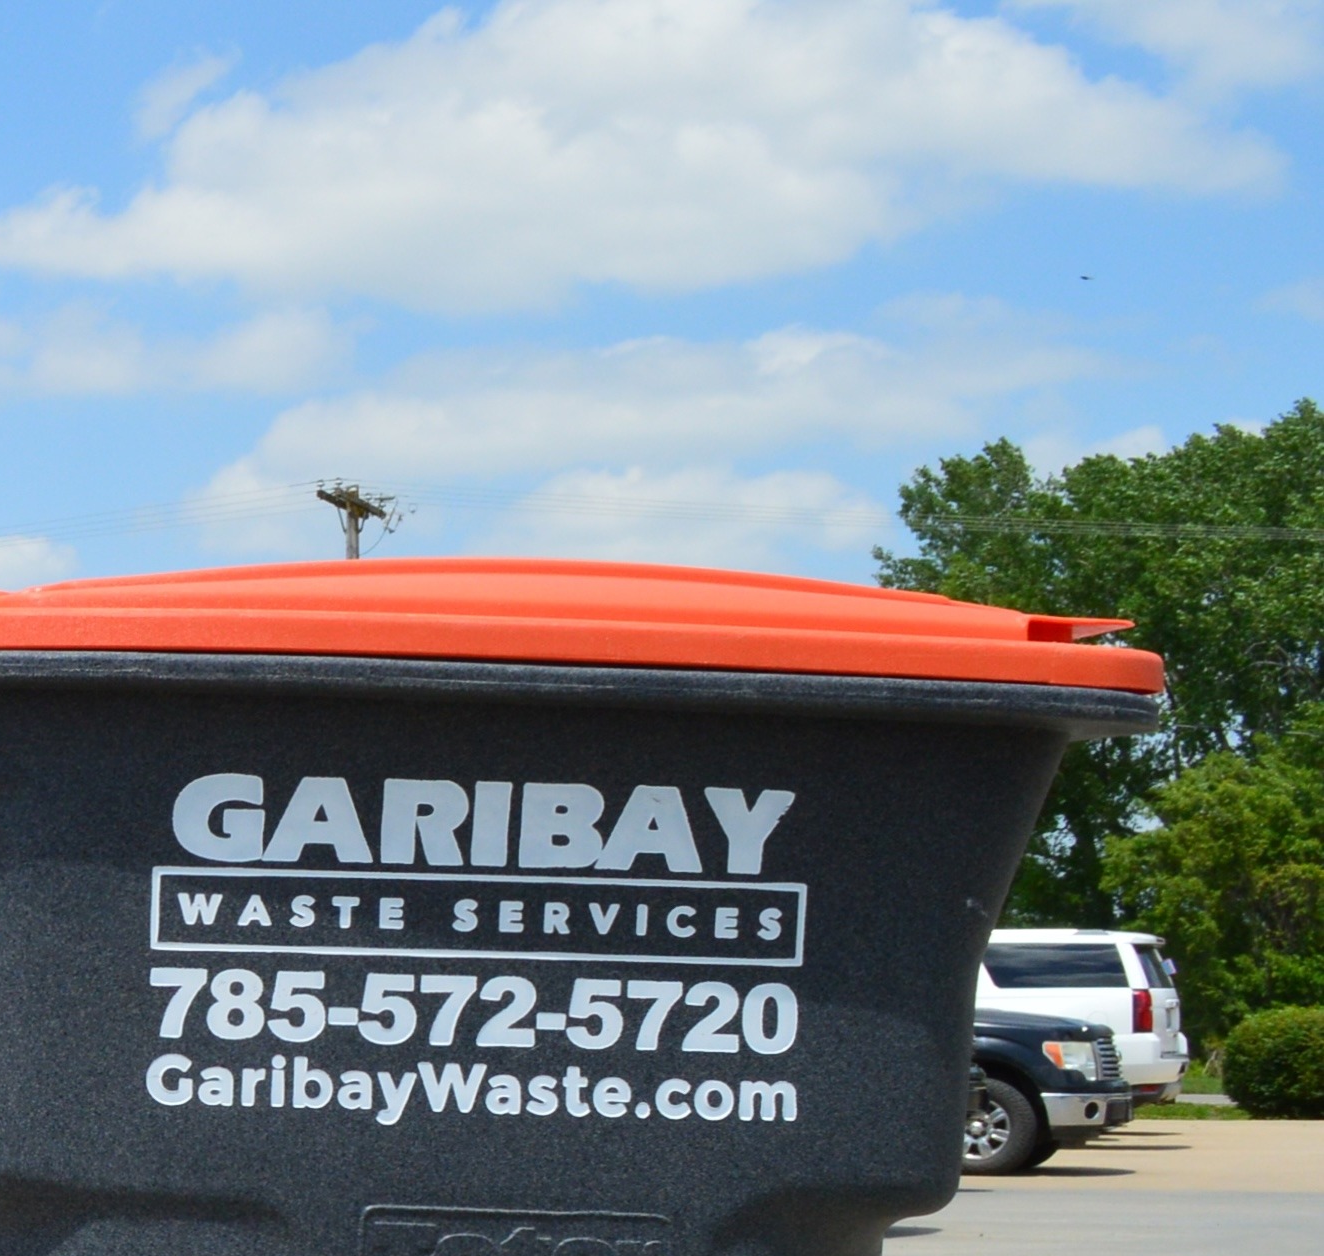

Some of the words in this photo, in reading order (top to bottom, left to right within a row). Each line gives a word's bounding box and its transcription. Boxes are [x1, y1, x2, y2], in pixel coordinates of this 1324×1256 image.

[171, 772, 796, 875] GARIBAY
[177, 892, 406, 930] WASTE
[452, 898, 784, 942] SERVICES
[149, 966, 800, 1056] 785-572-5720
[146, 1052, 798, 1127] GaribayWaste.com
